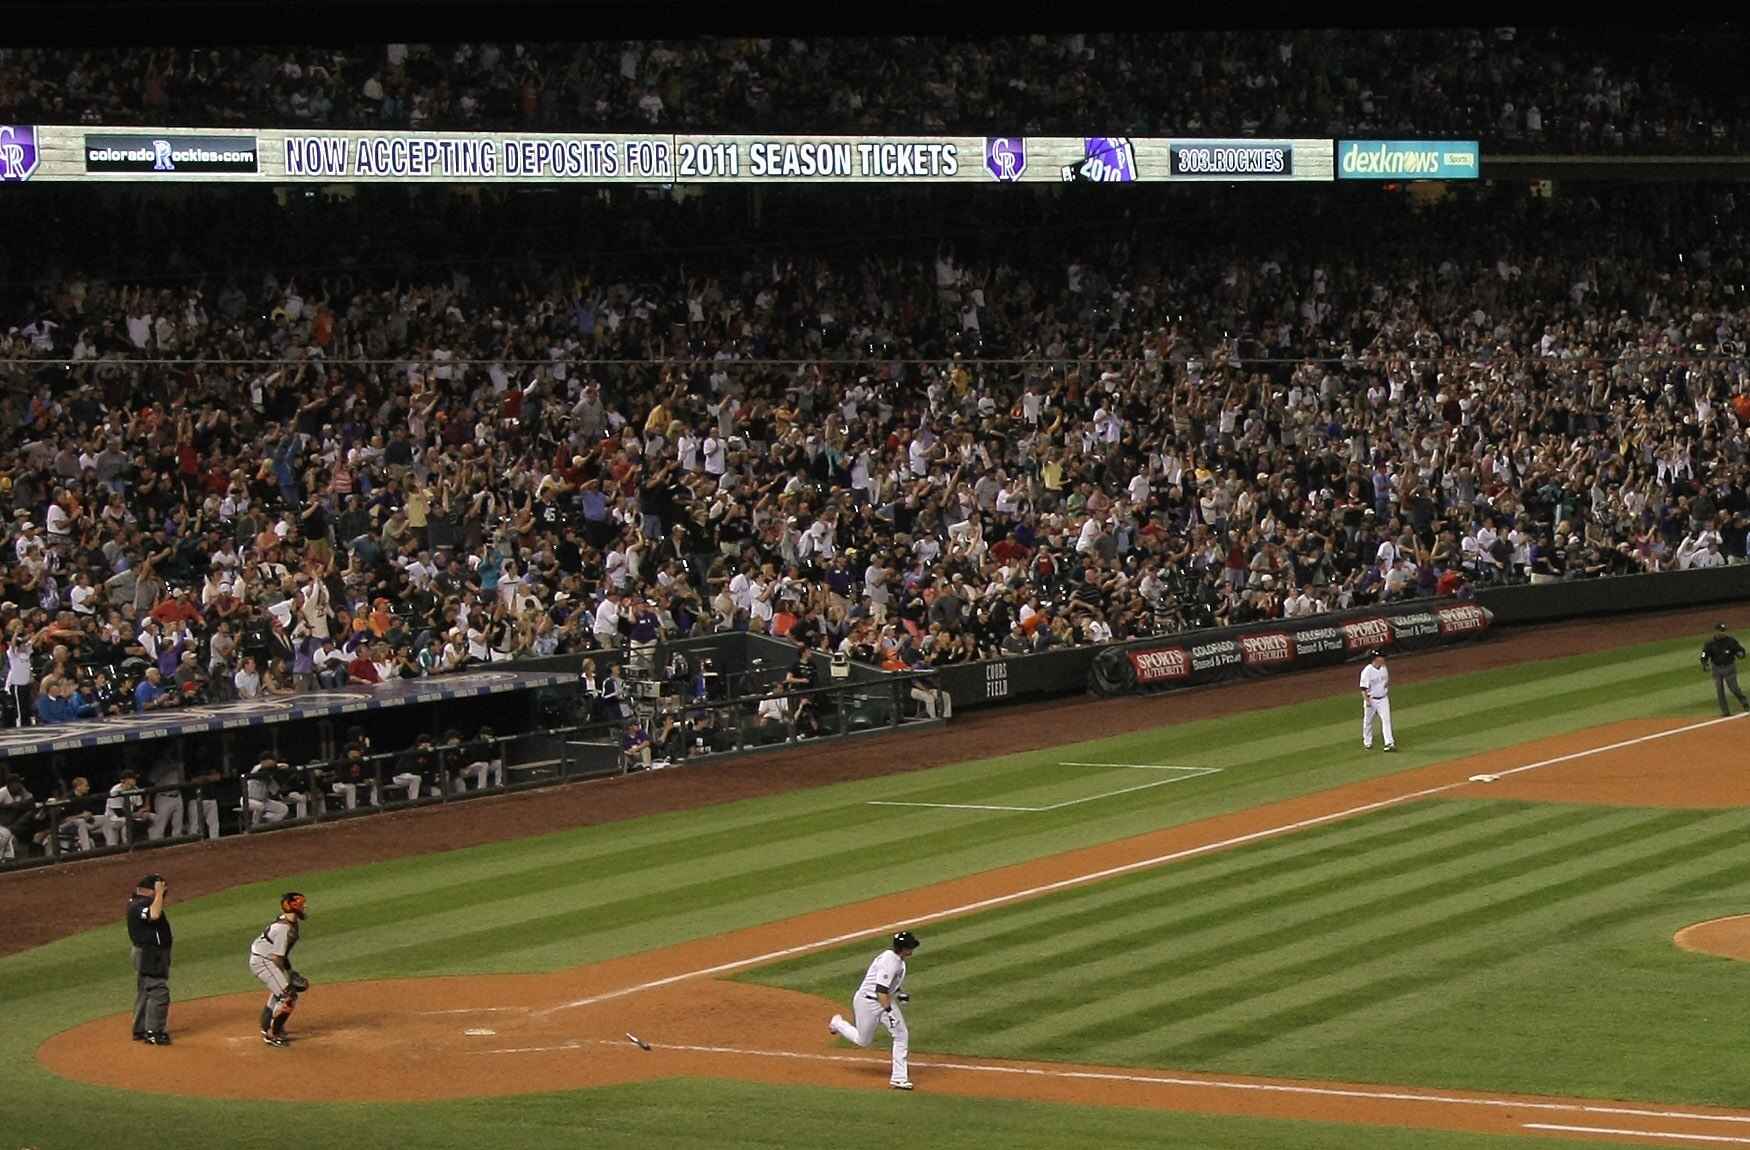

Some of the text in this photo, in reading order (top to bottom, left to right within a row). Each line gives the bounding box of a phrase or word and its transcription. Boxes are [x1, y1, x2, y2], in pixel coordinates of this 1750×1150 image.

[284, 136, 959, 178] NOW ACCEPTING DEPOSITS FOR 2011 SEASON TICKETS
[1178, 148, 1285, 173] 303.ROCKIES
[1343, 143, 1440, 174] dexknows
[1080, 157, 1122, 182] 2010
[1439, 605, 1483, 623] SPORTS
[1296, 628, 1336, 642] COLORADO
[1345, 619, 1388, 639] SPORTS
[1192, 640, 1235, 657] COLORADO
[1243, 634, 1288, 653] SPORTS
[1136, 650, 1185, 670] SPORTS
[1249, 649, 1289, 663] AUTHORITY
[986, 662, 1007, 681] COORS
[1142, 663, 1186, 679] AUTHORITY
[986, 679, 1008, 698] FIELD
